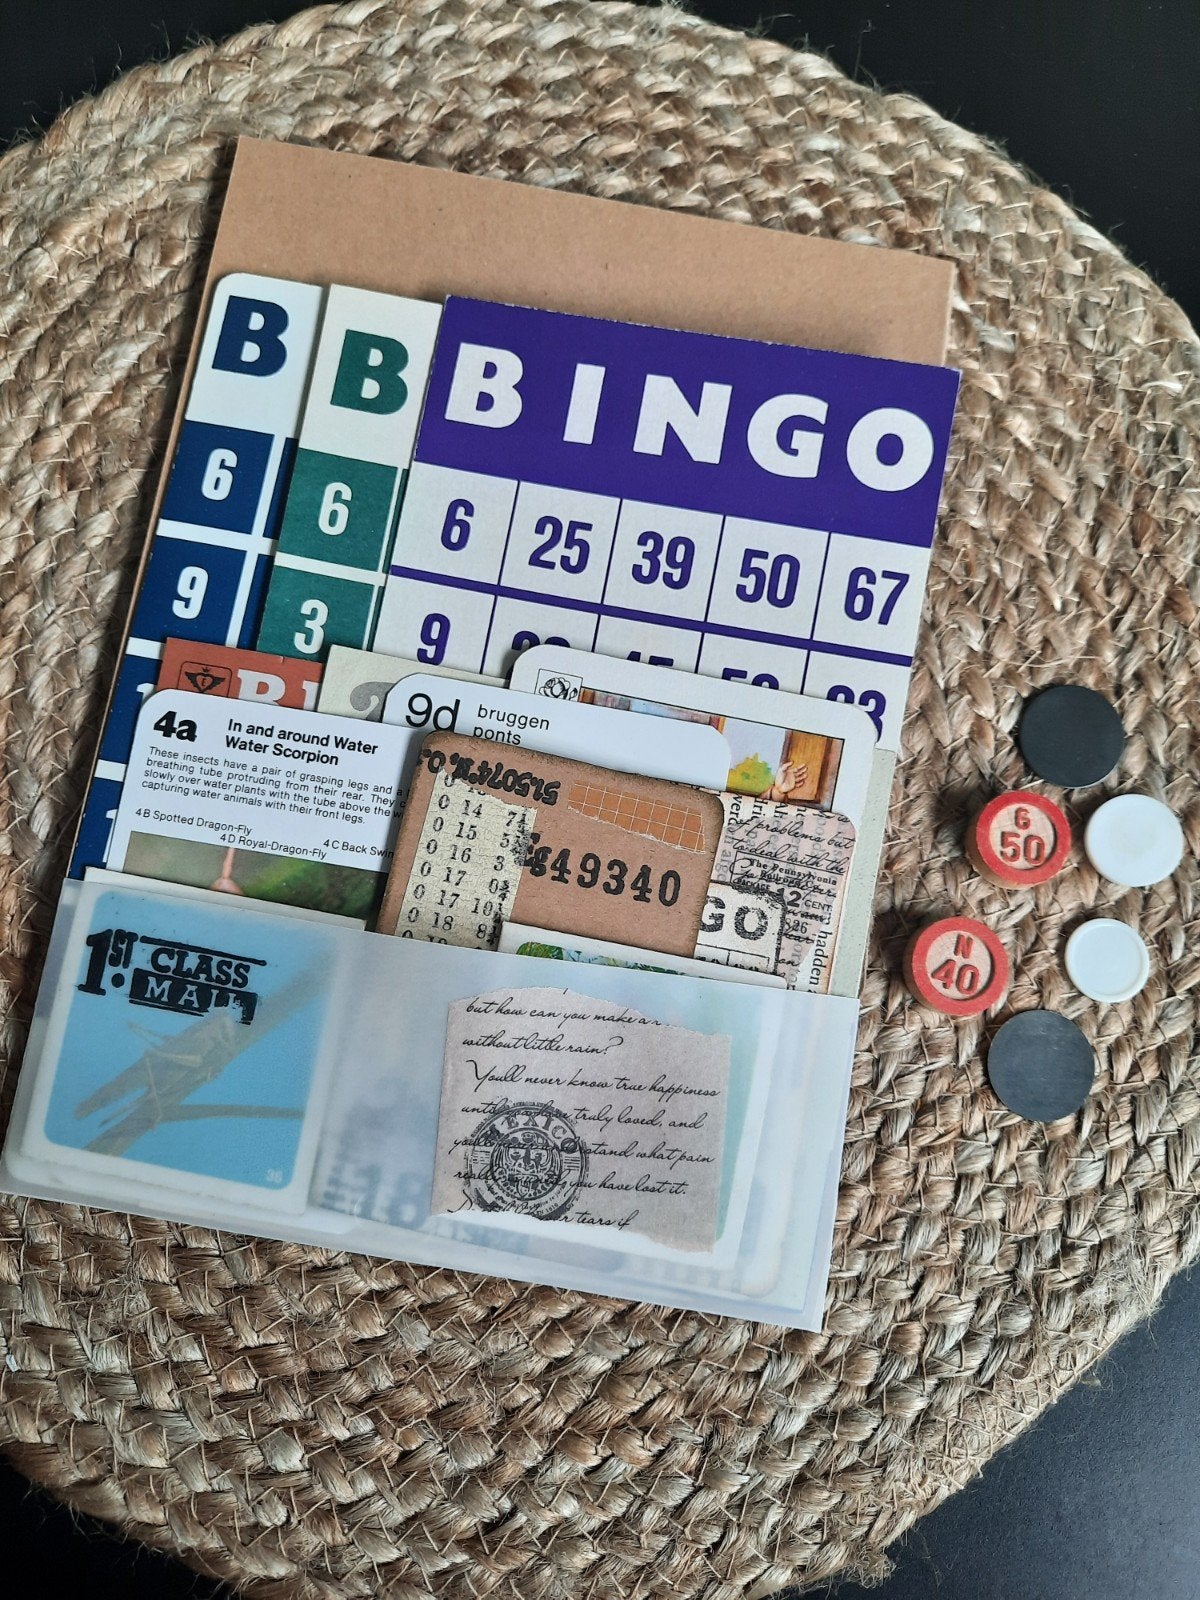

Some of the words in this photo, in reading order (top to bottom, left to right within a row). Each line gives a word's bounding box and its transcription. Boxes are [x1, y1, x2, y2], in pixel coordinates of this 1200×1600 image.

[212, 295, 289, 377] B
[330, 329, 409, 415] B
[201, 448, 238, 500] 6
[318, 482, 352, 536] 6
[440, 499, 474, 551] 6
[528, 516, 593, 574] 25
[631, 531, 695, 589] 39
[735, 549, 800, 608] 50
[844, 567, 910, 626] 67
[172, 566, 209, 619] 9
[293, 599, 329, 653] 3
[417, 613, 451, 665] 9
[154, 711, 197, 742] 4a
[406, 693, 460, 731] 9d
[477, 704, 550, 730] bruggen
[225, 735, 269, 754] Water
[272, 743, 339, 766] Scorpion
[228, 719, 242, 732] In
[249, 722, 274, 738] and
[278, 731, 330, 747] around
[334, 735, 379, 755] Water
[473, 725, 522, 746] ponts
[147, 757, 195, 775] breathing
[200, 765, 222, 778] tube
[227, 771, 281, 789] protruding
[285, 780, 310, 793] from
[314, 784, 338, 797] their
[341, 790, 365, 802] rear.
[370, 793, 395, 807] They
[149, 746, 178, 759] These
[183, 751, 219, 766] insects
[223, 759, 248, 771] have
[261, 764, 281, 778] pair
[285, 768, 297, 778] of
[299, 772, 343, 788] grasping
[347, 778, 369, 791] legs
[373, 783, 392, 795] and
[141, 780, 196, 797] capturing
[192, 788, 221, 801] water
[224, 793, 261, 807] animals
[265, 799, 286, 811] with
[289, 803, 313, 816] their
[315, 807, 340, 820] front
[342, 811, 366, 825] legs.
[144, 769, 175, 785] slowly
[178, 775, 200, 786] over
[204, 779, 232, 791] water
[234, 784, 266, 799] plants
[269, 789, 290, 801] with
[293, 792, 309, 804] the
[313, 796, 336, 808] tube
[339, 801, 370, 814] above
[374, 805, 391, 818] the
[438, 795, 450, 809] 0
[462, 800, 483, 818] 14
[153, 811, 194, 827] Spotted
[196, 817, 253, 836] Dragon-Fly
[433, 817, 443, 831] 0
[456, 822, 477, 840] 15
[746, 821, 825, 842] problems
[828, 832, 856, 848] but
[1014, 807, 1030, 831] G
[238, 837, 327, 860] Royal-Dragon-Fly
[342, 841, 367, 855] Back
[426, 839, 437, 854] 0
[450, 844, 472, 863] 16
[494, 856, 505, 871] 3
[1000, 831, 1046, 867] 50
[420, 862, 431, 876] 0
[443, 867, 467, 886] 17
[414, 884, 425, 899] 0
[437, 890, 460, 908] 17
[408, 907, 419, 922] 0
[432, 912, 453, 930] 18
[809, 931, 833, 985] hadden
[955, 934, 973, 957] N
[151, 948, 250, 988] CLASS
[932, 958, 980, 995] 40
[466, 997, 498, 1014] but
[495, 997, 526, 1015] how
[558, 1013, 590, 1028] you
[594, 1009, 637, 1023] make
[462, 1030, 524, 1050] without
[523, 1032, 565, 1051] little
[564, 1036, 624, 1055] rain?
[525, 1076, 565, 1086] never
[567, 1068, 614, 1088] know
[614, 1076, 646, 1091] true
[649, 1074, 720, 1102] happiness
[574, 1104, 614, 1132] truly
[618, 1106, 666, 1127] loved,
[669, 1112, 707, 1129] and
[636, 1141, 682, 1160] what
[670, 1150, 715, 1170] pain
[598, 1171, 634, 1191] have
[636, 1174, 672, 1194] lost
[669, 1182, 689, 1194] it.
[575, 1210, 616, 1225] tears
[615, 1210, 639, 1230] if
